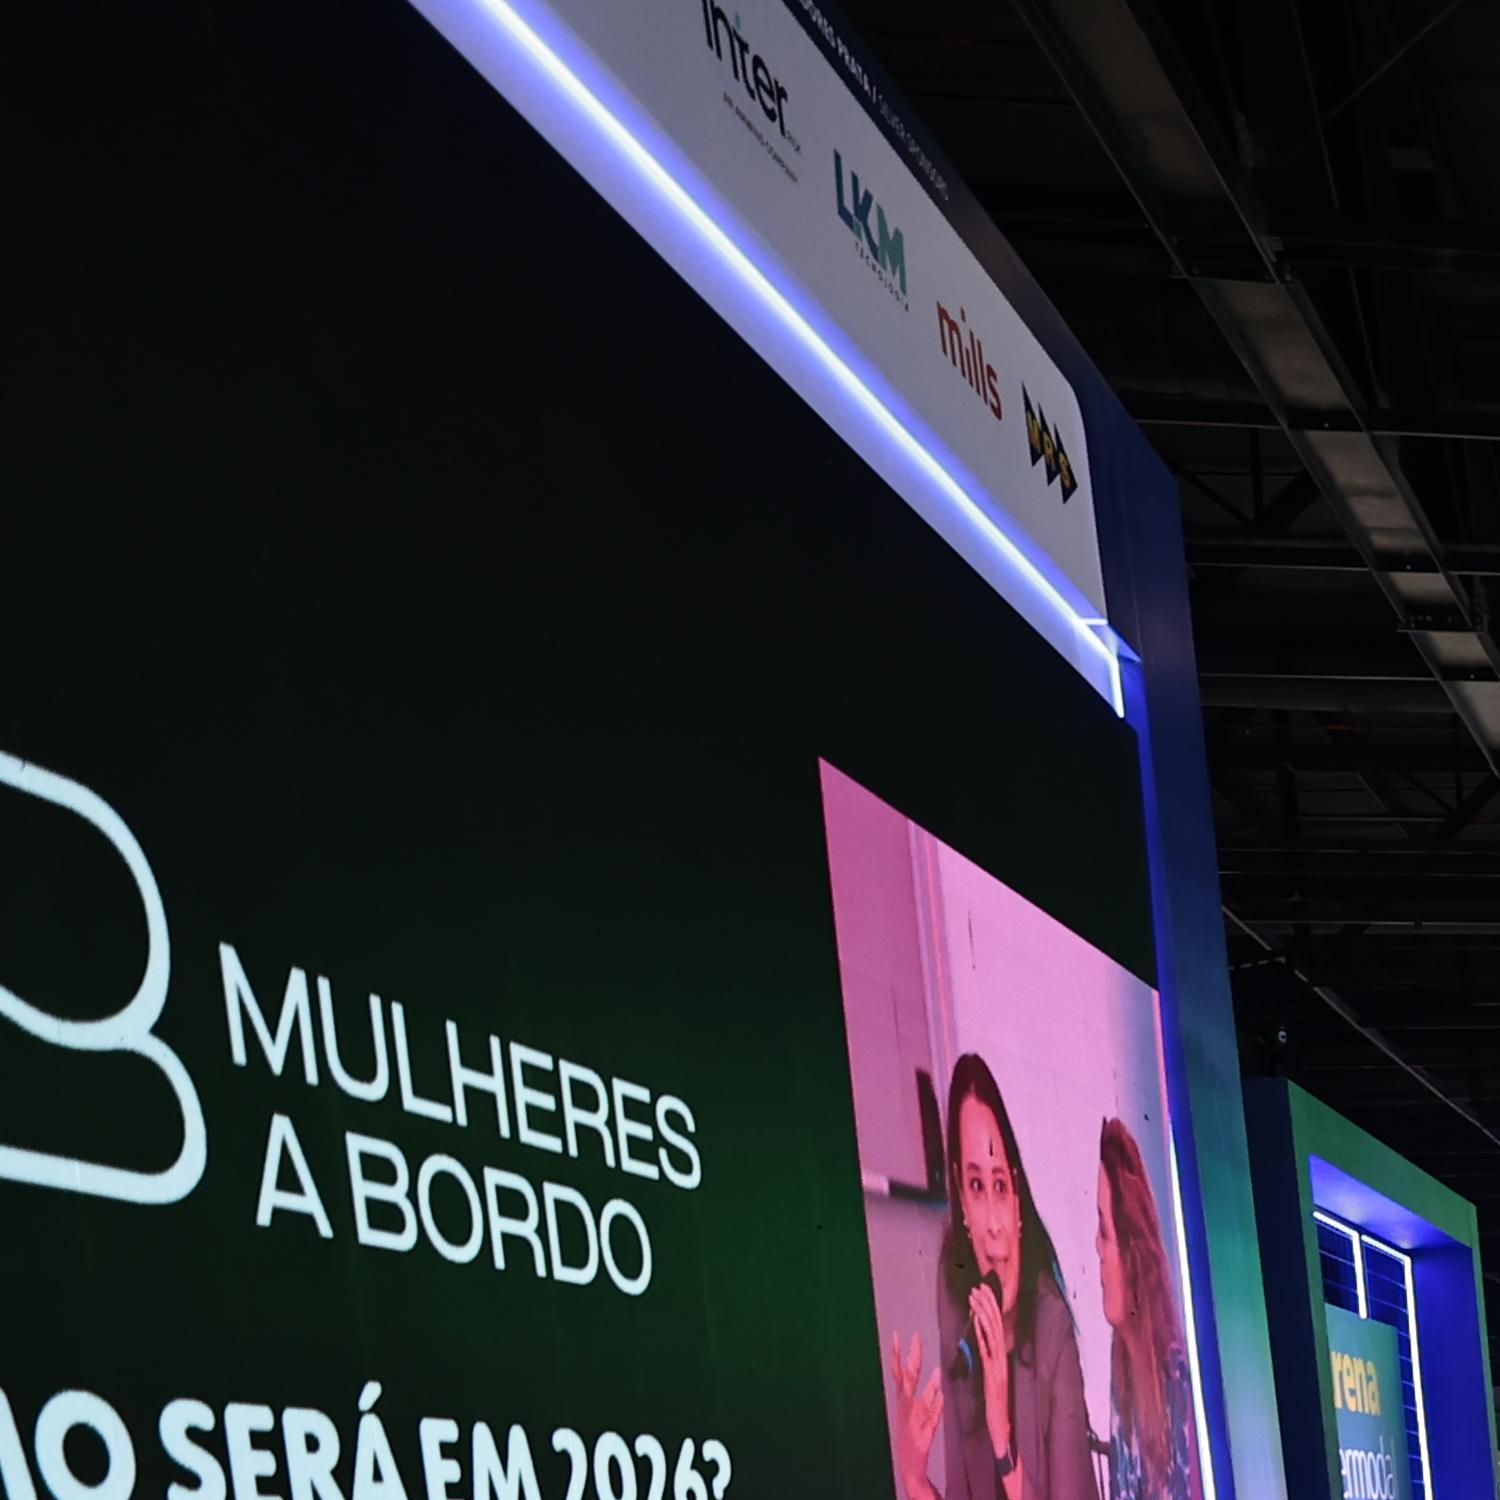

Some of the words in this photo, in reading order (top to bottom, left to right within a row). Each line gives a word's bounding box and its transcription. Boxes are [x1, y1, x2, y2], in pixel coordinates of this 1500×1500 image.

[834, 148, 907, 296] LKM
[937, 300, 1002, 421] mills
[218, 942, 702, 1190] MULHERES
[254, 1112, 334, 1239] A
[345, 1130, 653, 1297] BORDO
[1331, 1350, 1381, 1416] rena
